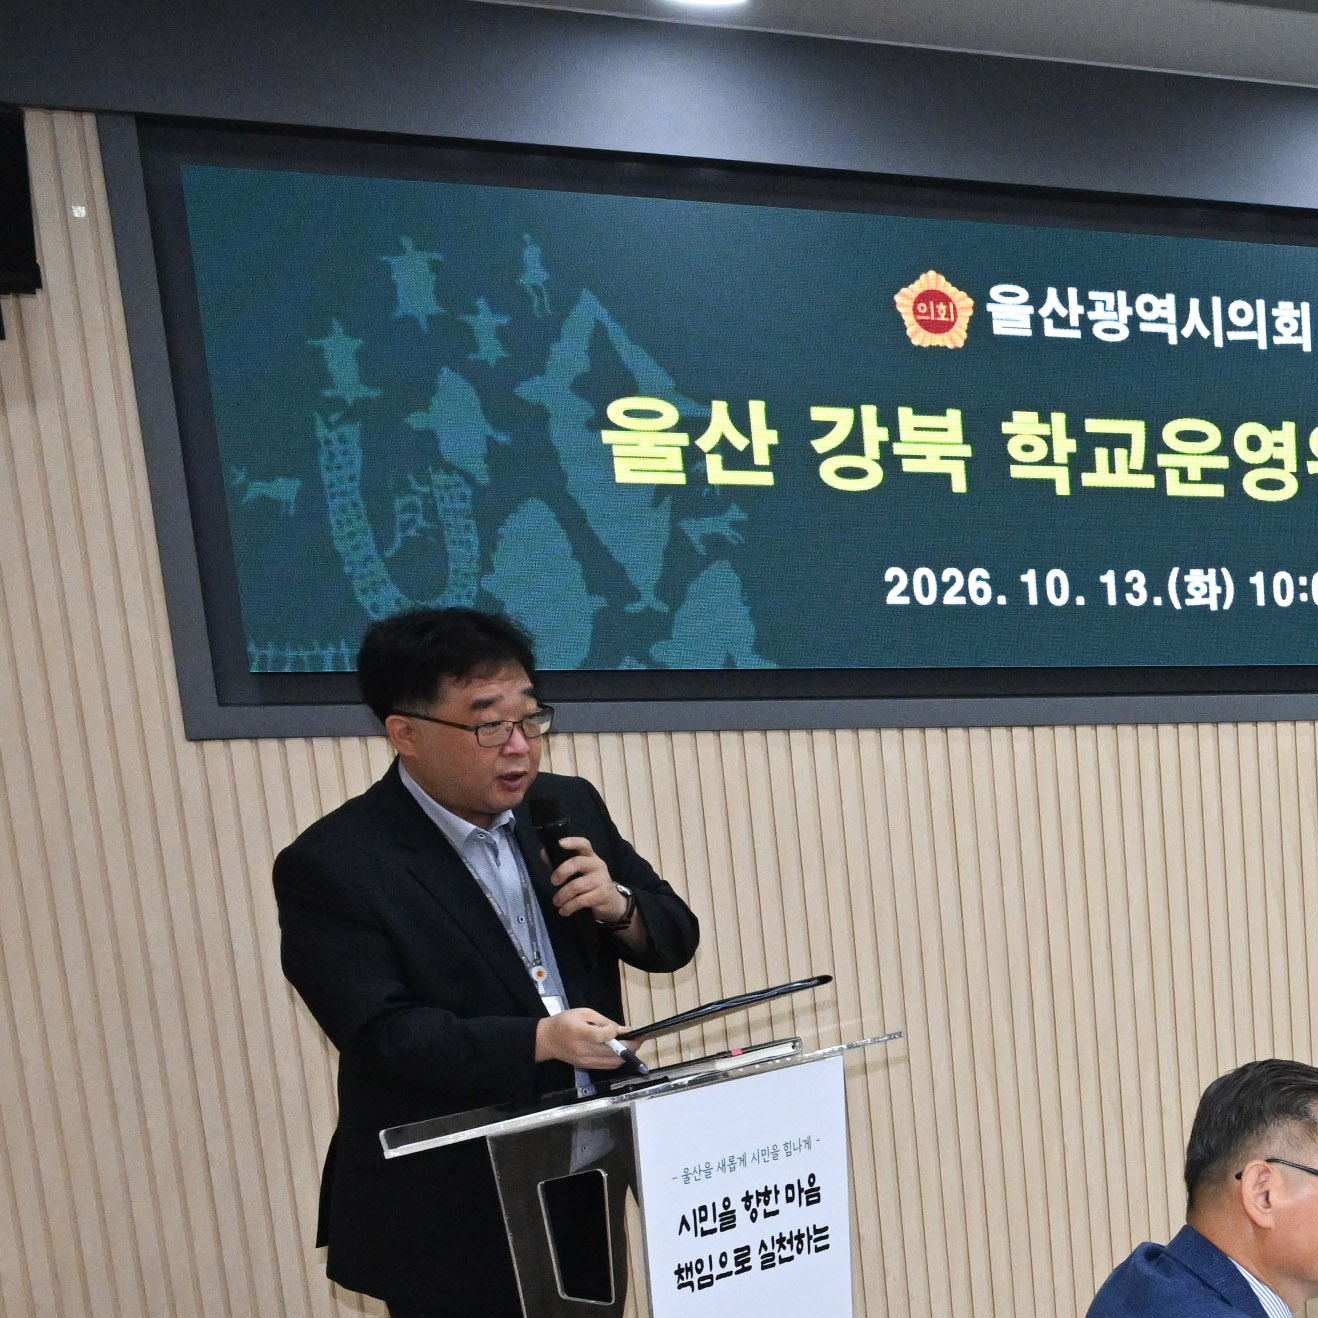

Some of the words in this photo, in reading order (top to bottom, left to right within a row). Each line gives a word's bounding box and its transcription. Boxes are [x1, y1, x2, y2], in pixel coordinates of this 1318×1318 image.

[917, 302, 954, 322] 의회
[986, 284, 1311, 352] 울산광역시의회
[601, 396, 779, 485] 울산
[809, 405, 972, 493] 강북
[884, 566, 1007, 605] 2026.
[1020, 568, 1085, 606] 10.
[1099, 567, 1235, 611] 13.(화)
[681, 1161, 713, 1184] 울산을
[716, 1152, 747, 1173] 새롭게
[750, 1144, 780, 1164] 시민을
[783, 1135, 812, 1157] 힘나게
[678, 1196, 736, 1238] 시민을
[741, 1184, 780, 1223] 향한
[785, 1173, 821, 1207] 마음
[674, 1245, 752, 1293] 책임으로
[758, 1224, 830, 1271] 실천하는
